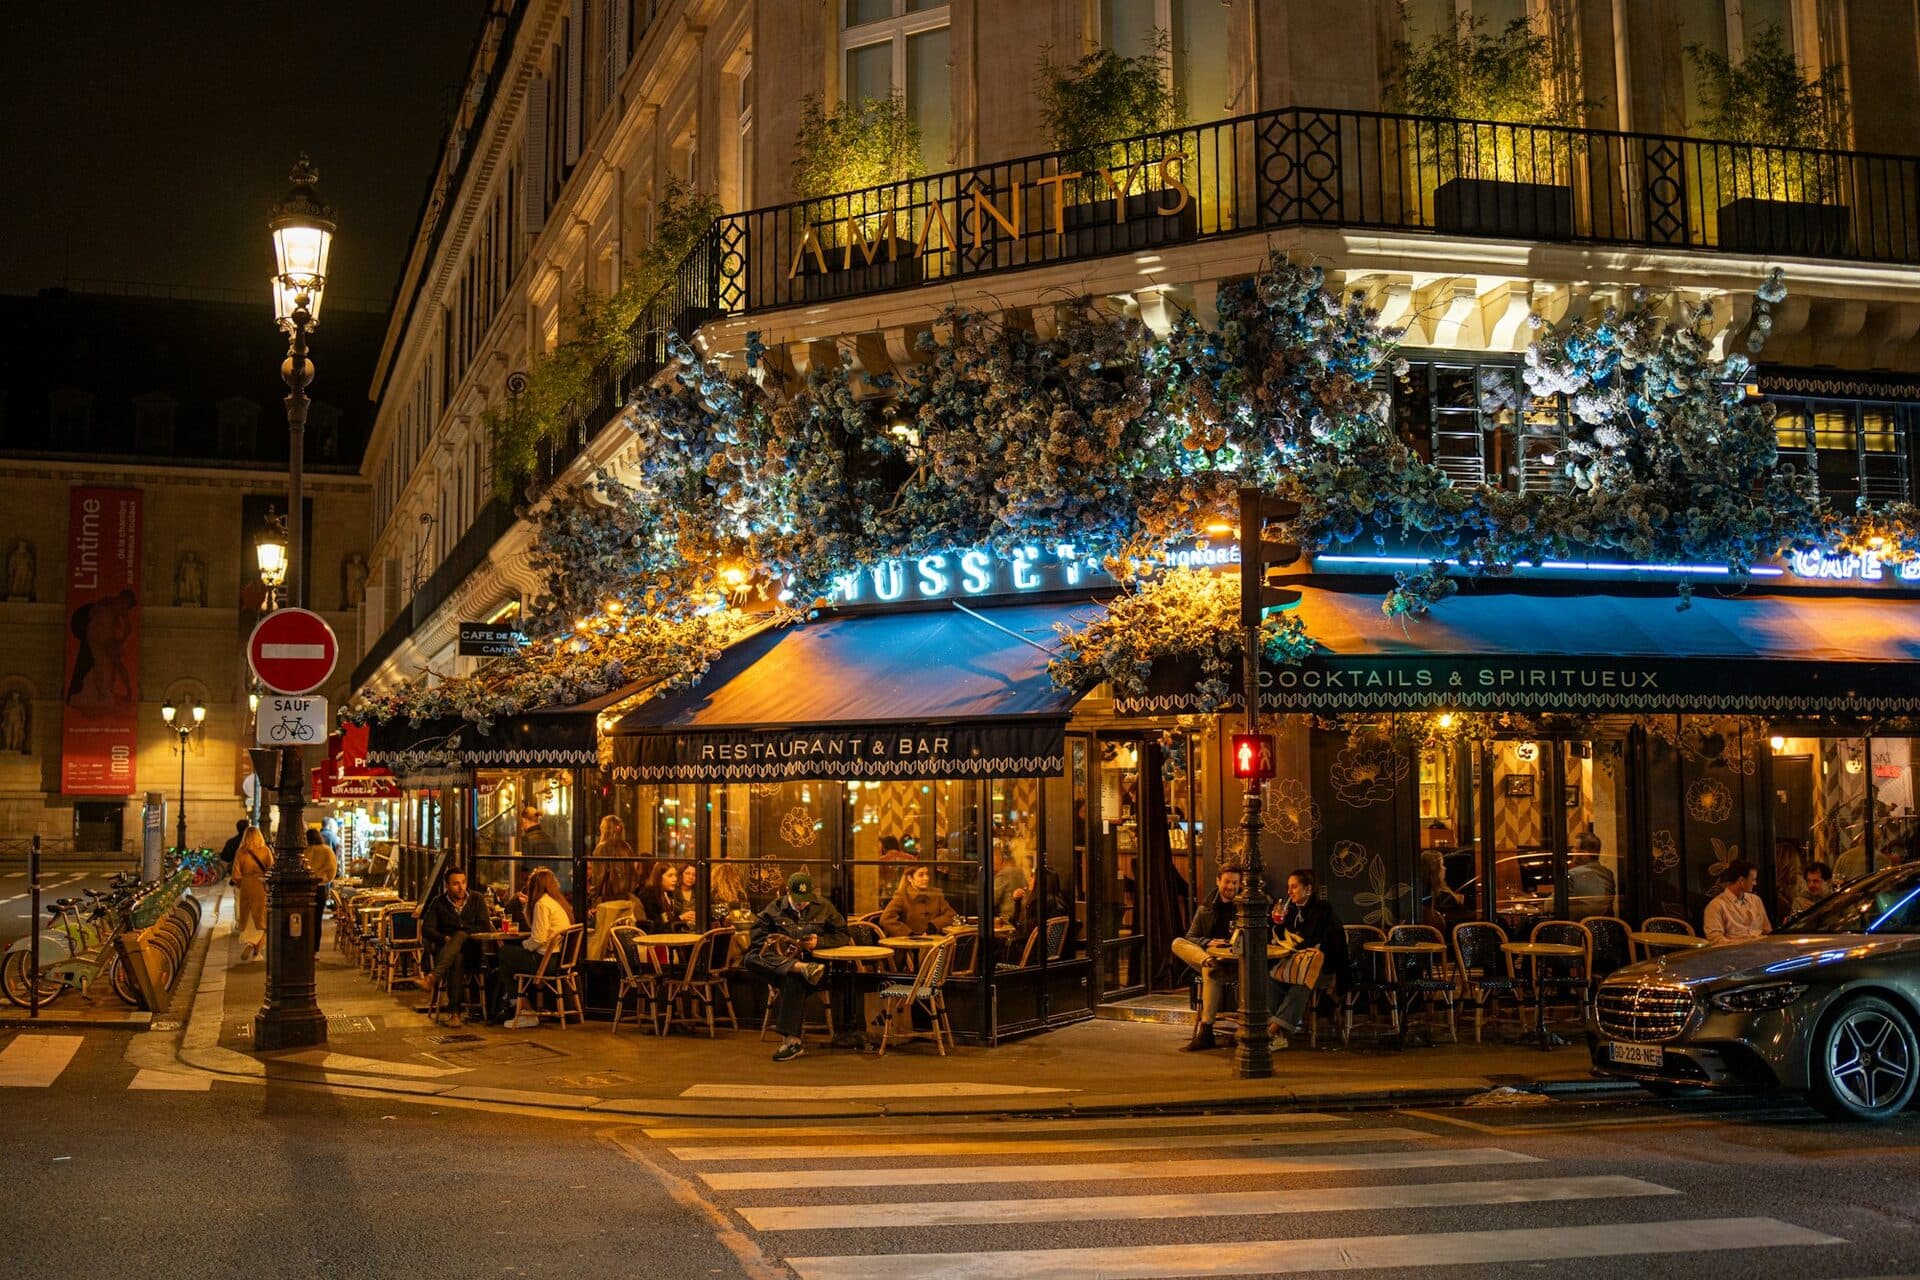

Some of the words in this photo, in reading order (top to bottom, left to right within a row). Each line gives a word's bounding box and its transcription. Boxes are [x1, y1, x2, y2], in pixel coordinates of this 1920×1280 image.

[788, 151, 1190, 280] AMANTYS
[74, 498, 100, 589] L'intime
[461, 630, 494, 640] CAFE
[1258, 669, 1433, 688] COCKTAILS
[1448, 671, 1463, 686] &
[1479, 669, 1659, 688] SPIRITUEUX
[274, 699, 311, 712] SAUF
[702, 738, 862, 761] RESTAURANT
[872, 740, 885, 756] &
[899, 738, 949, 755] BAR
